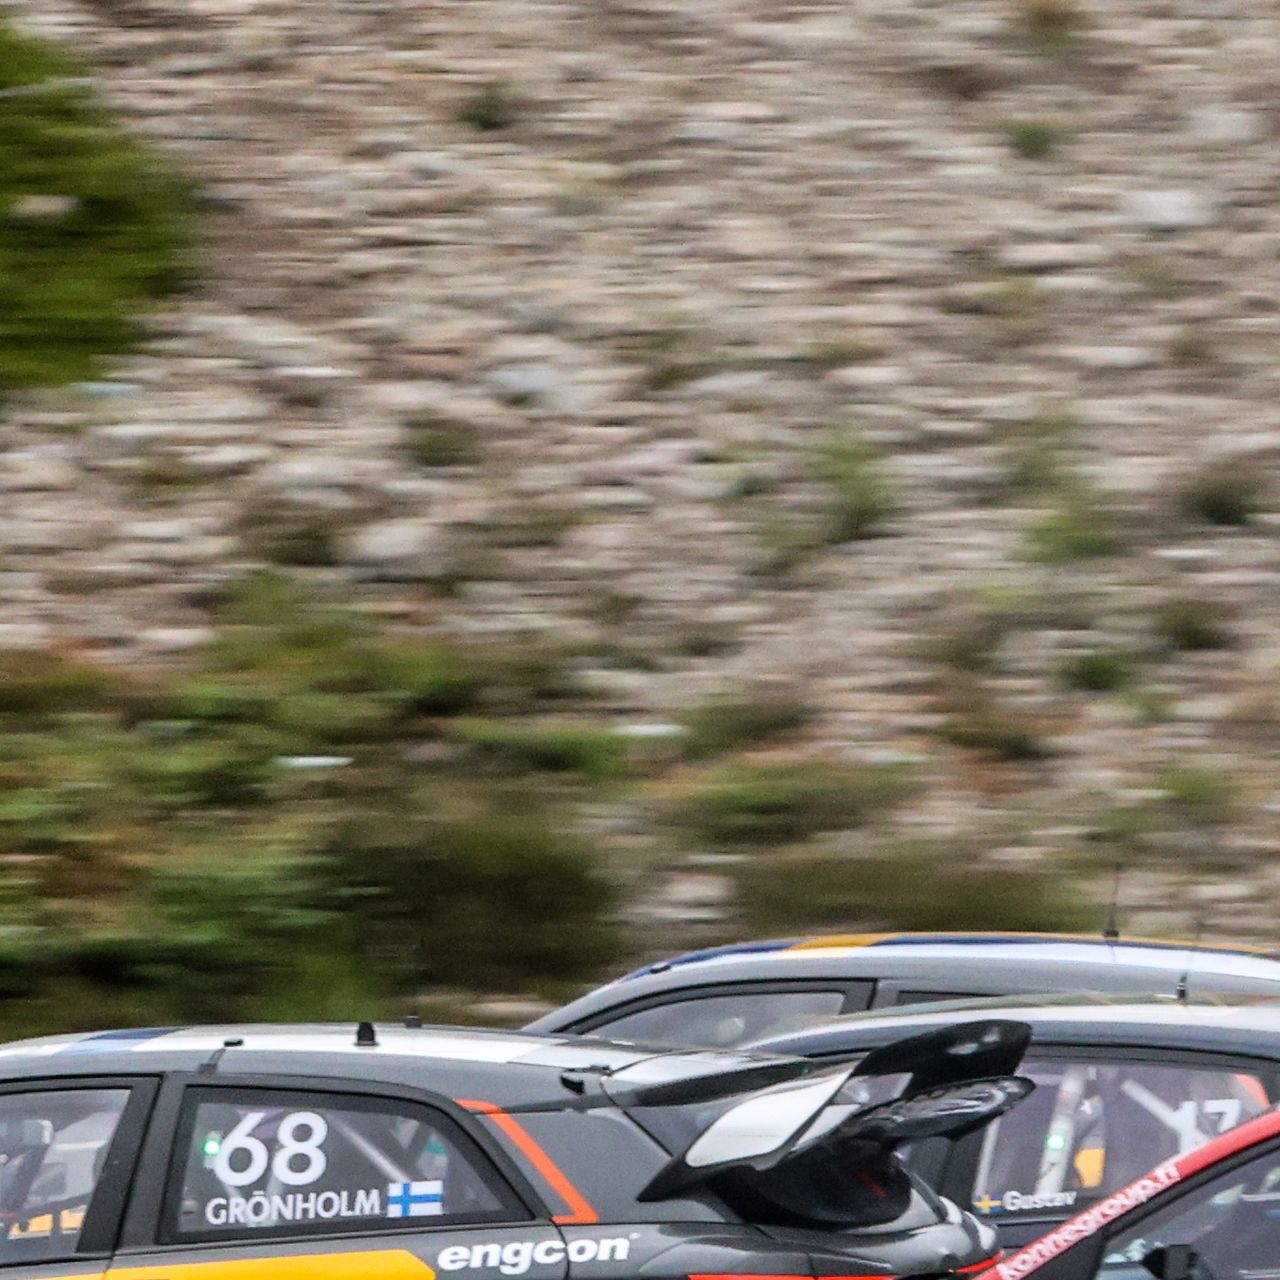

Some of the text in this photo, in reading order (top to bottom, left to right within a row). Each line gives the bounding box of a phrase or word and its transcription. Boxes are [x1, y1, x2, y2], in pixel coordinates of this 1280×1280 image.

[215, 1111, 328, 1187] 68
[205, 1190, 381, 1225] GRÖNHOLM
[438, 1236, 630, 1274] engcon
